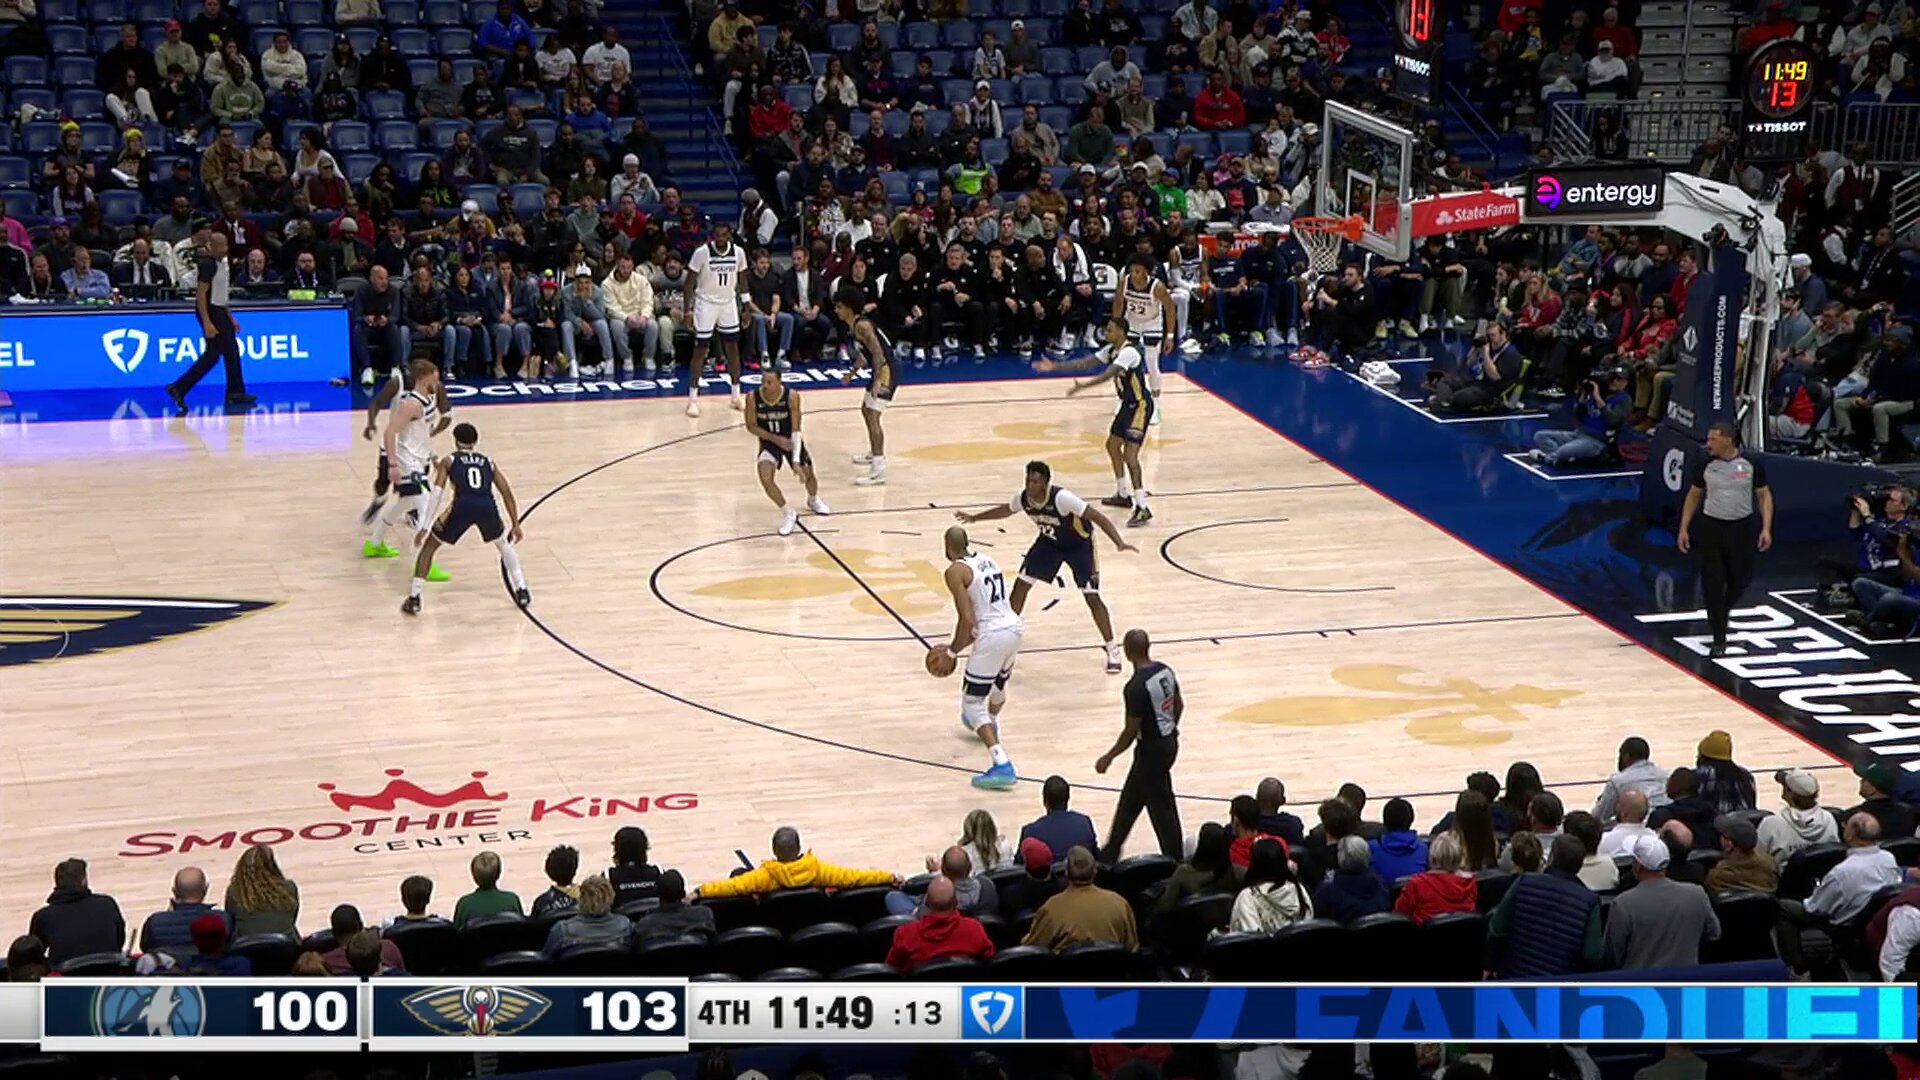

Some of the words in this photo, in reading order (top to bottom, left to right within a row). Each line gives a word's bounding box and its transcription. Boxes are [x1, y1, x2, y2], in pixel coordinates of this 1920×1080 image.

[1763, 61, 1808, 81] 11:49
[1770, 82, 1797, 107] 13
[1763, 121, 1807, 133] TISSOT
[1566, 182, 1657, 206] entergy
[717, 272, 728, 287] 11
[1128, 302, 1146, 316] 22
[158, 334, 309, 363] FAUEL
[1712, 294, 1727, 410] NEWAGEPRODUCTS.COM
[444, 375, 680, 399] Ochsner
[766, 420, 781, 433] 11
[467, 466, 482, 489] 0
[1662, 447, 1685, 493] G
[984, 572, 1005, 603] 27
[1633, 604, 1920, 773] PELICA
[119, 808, 504, 857] SMOOTHIE
[354, 829, 533, 855] CENTER
